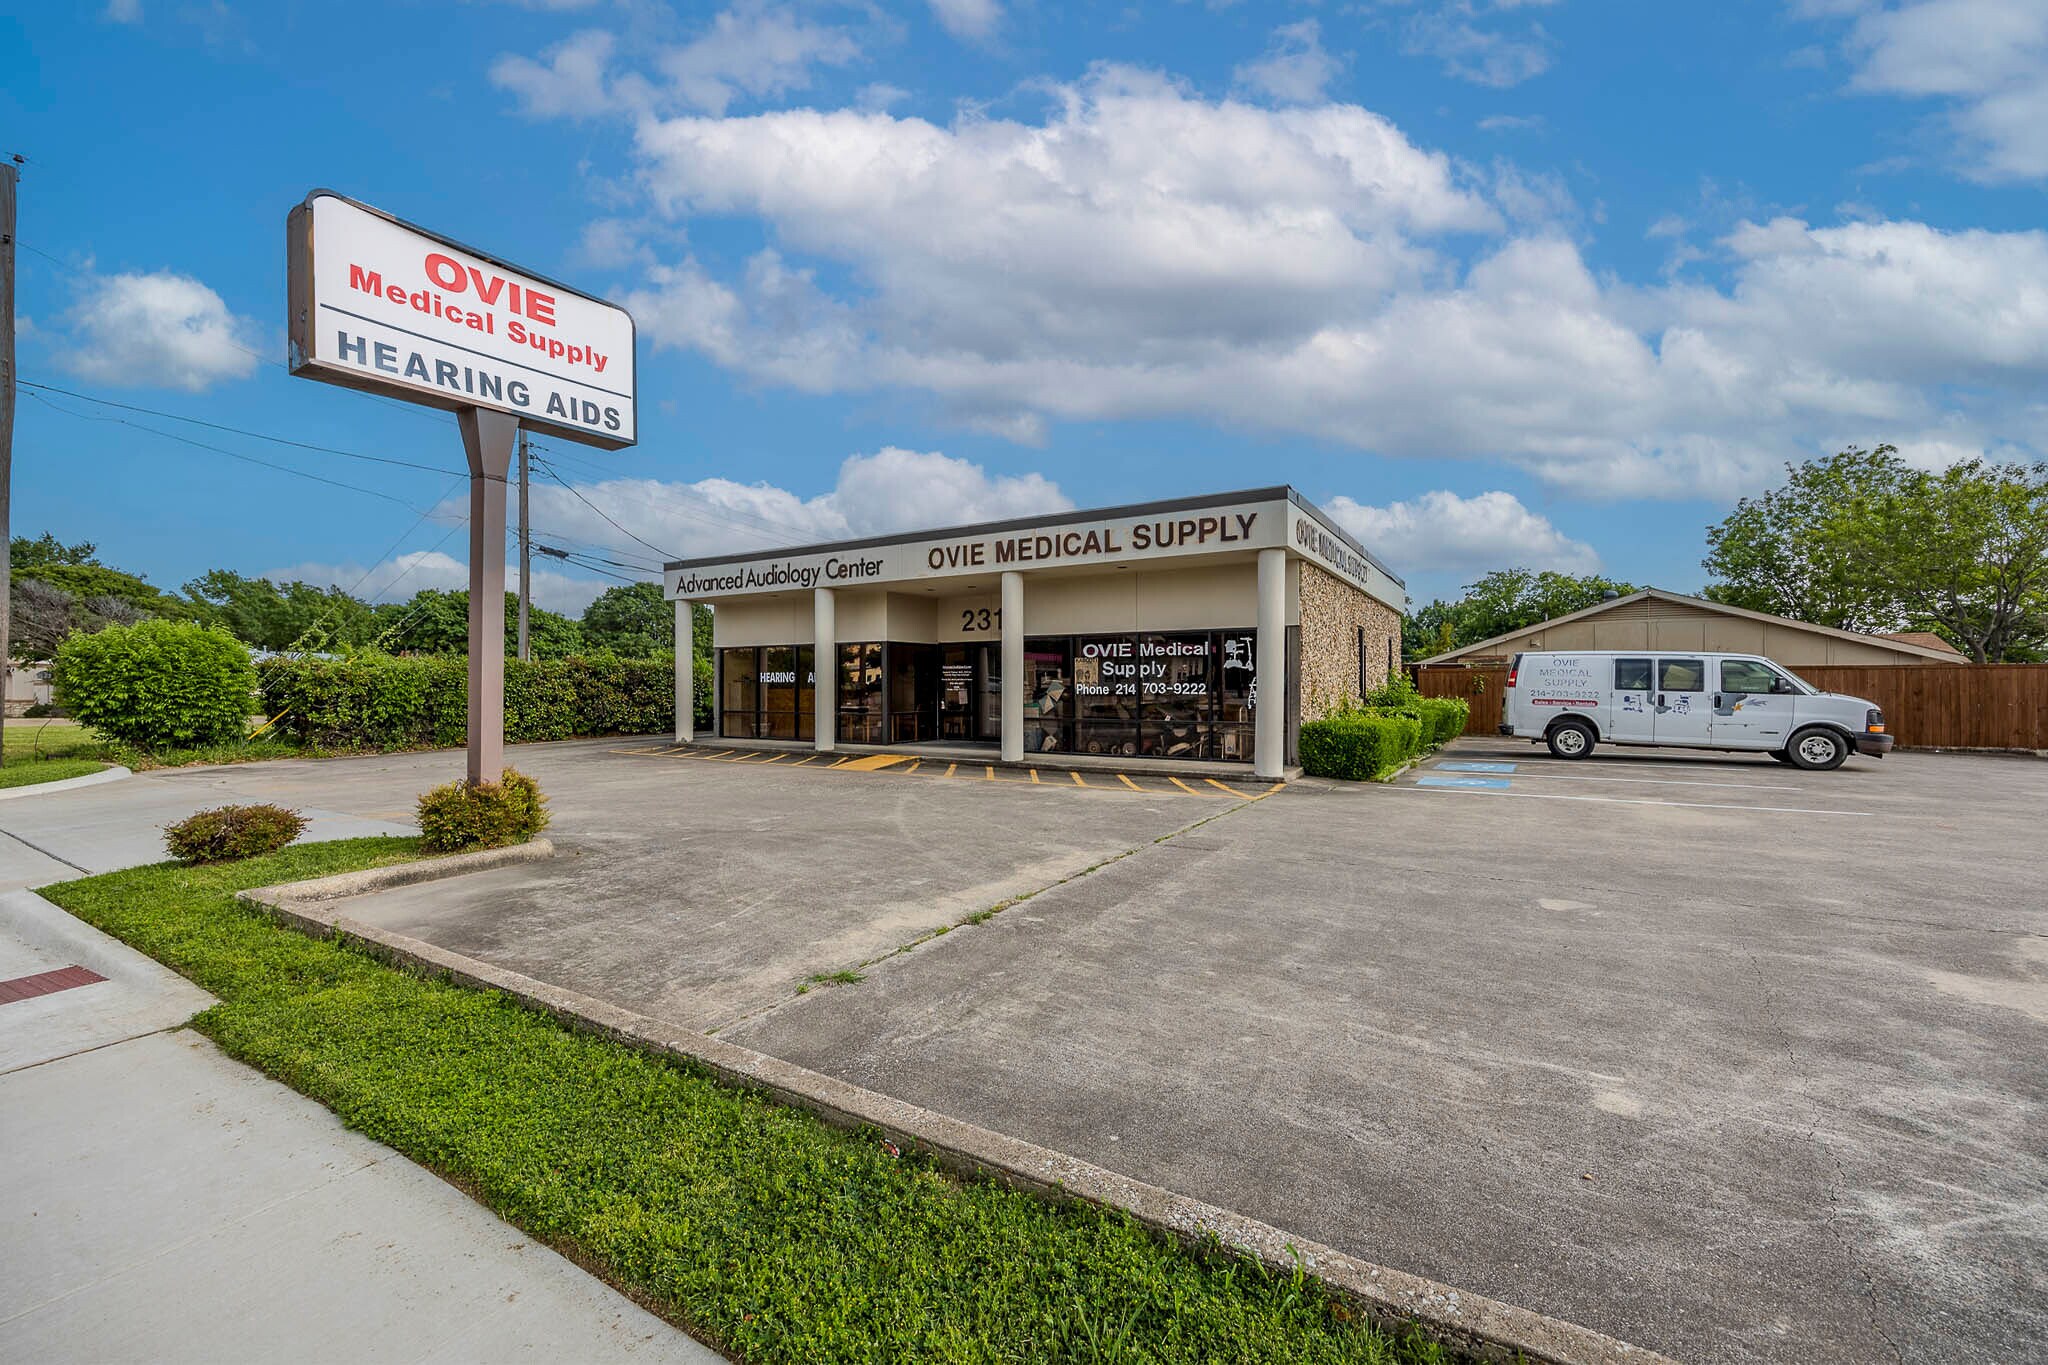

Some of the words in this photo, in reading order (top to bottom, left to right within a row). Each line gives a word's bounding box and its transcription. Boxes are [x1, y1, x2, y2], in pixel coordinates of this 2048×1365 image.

[424, 253, 556, 326] OVIE
[349, 263, 495, 334] Medical
[507, 320, 609, 373] Supply
[337, 331, 531, 406] HEARING
[546, 392, 621, 430] AIDS
[928, 542, 985, 569] OVIE
[995, 529, 1122, 564] MEDICAL
[1132, 512, 1258, 550] SUPPLY
[676, 568, 743, 594] Advanced
[745, 562, 821, 588] Audiology
[825, 557, 884, 580] Center
[1082, 643, 1132, 658] OVIE
[1140, 641, 1209, 657] Medical
[1553, 658, 1580, 667] OVIE
[760, 671, 796, 683] HEARING
[1540, 668, 1592, 678] MEDICAL
[1076, 683, 1110, 695] Phone
[1115, 683, 1137, 695] 214
[1142, 682, 1207, 695] 703-9222
[1544, 678, 1588, 688] SUPPLY
